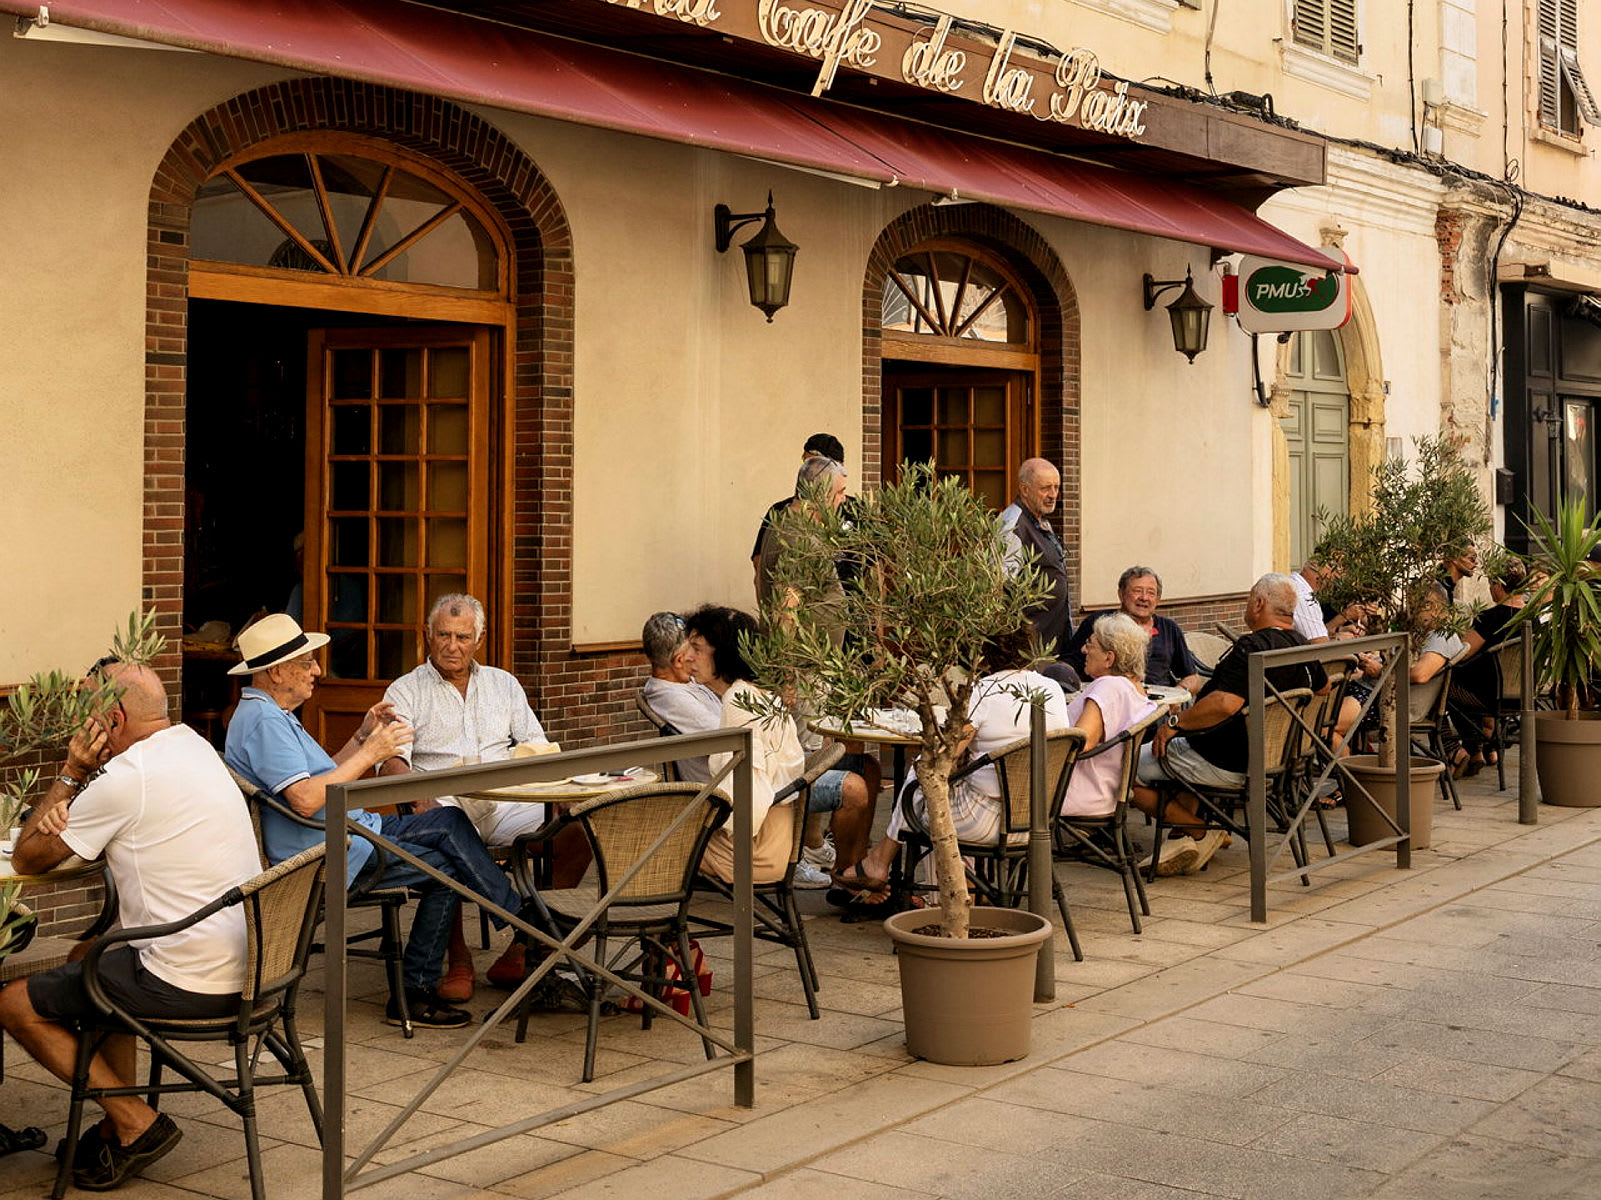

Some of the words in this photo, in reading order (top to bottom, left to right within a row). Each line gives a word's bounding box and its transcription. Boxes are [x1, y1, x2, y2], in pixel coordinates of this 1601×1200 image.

[902, 15, 966, 92] de
[983, 28, 1035, 112] la
[1050, 48, 1148, 138] Paix
[1256, 282, 1298, 300] PMU
